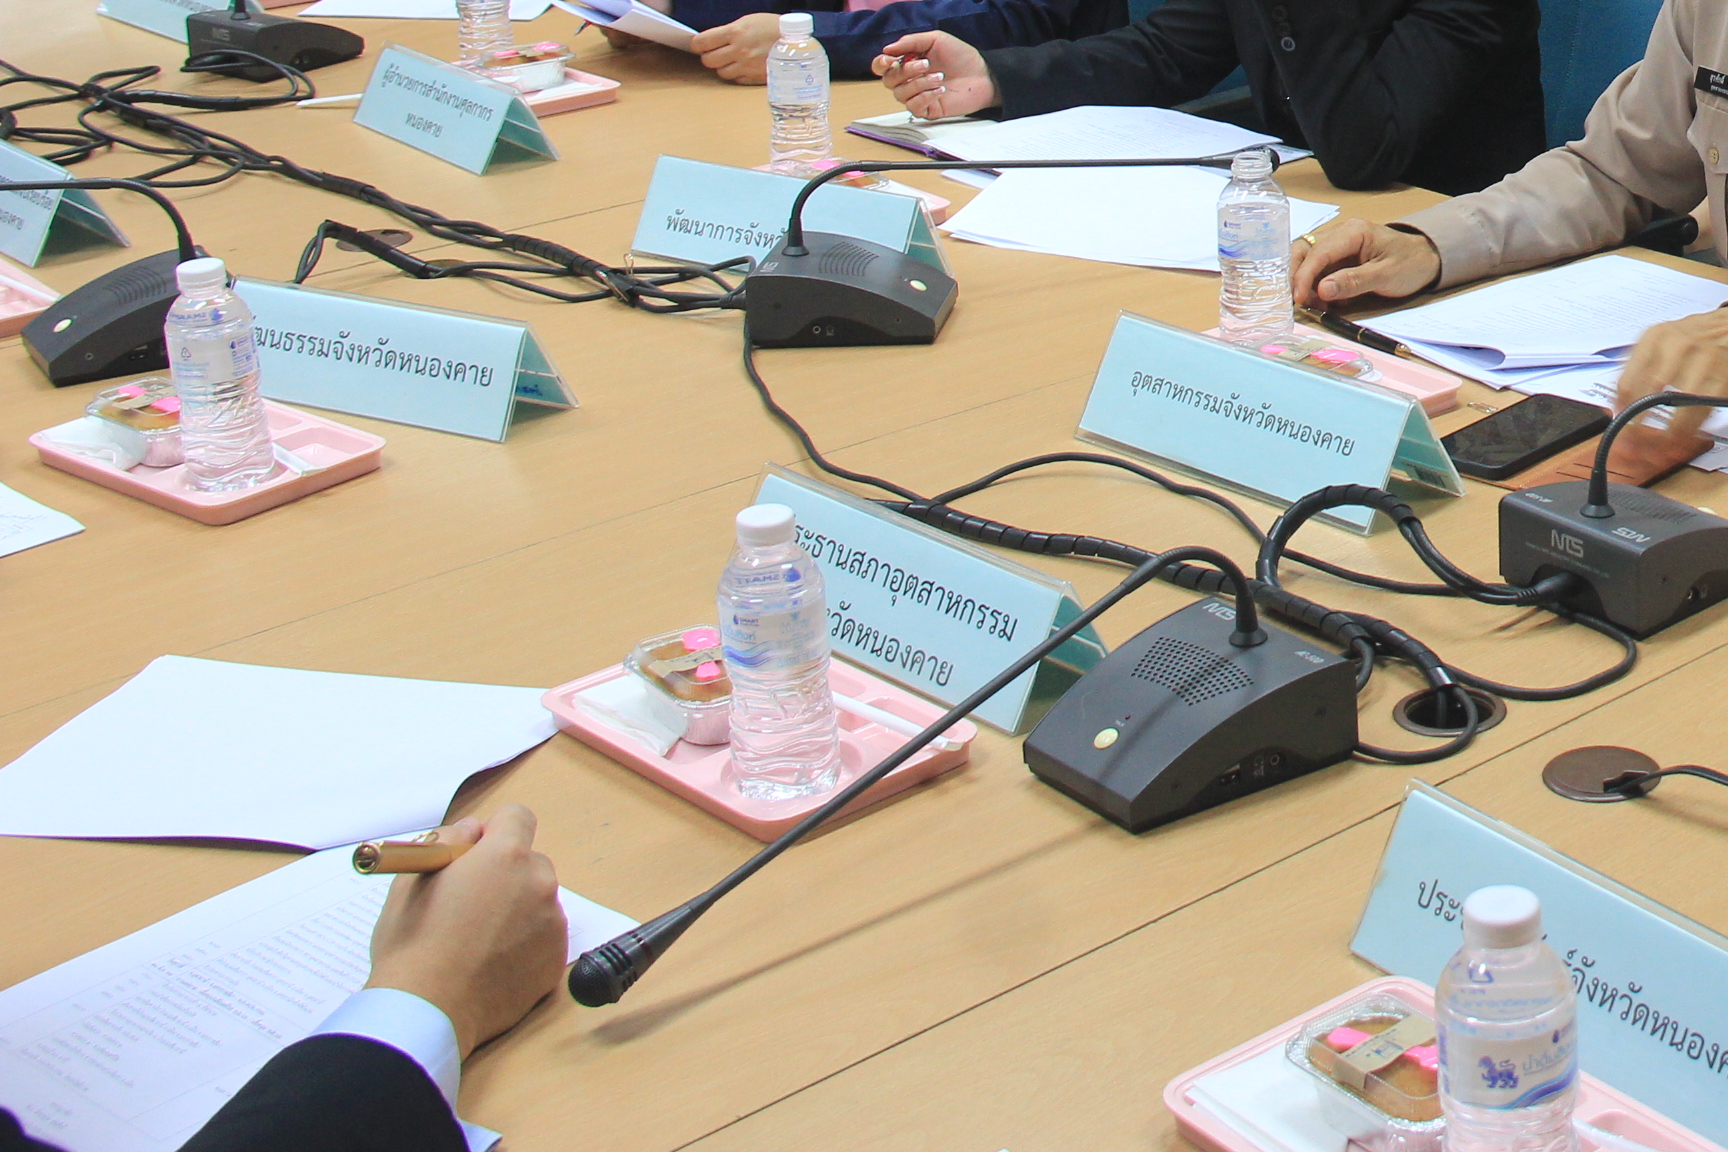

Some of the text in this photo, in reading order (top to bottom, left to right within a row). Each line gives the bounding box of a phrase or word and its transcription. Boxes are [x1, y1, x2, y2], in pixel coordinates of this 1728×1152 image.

[405, 113, 444, 138] หนองคาย
[254, 316, 494, 387] ฒนธรรมจังหวัดหนองคาย
[1131, 370, 1356, 457] อุตสาหกรรมจังหวัดหนองคาย
[794, 520, 1018, 642] ระธานสภาอุตสาหกรรม
[1551, 529, 1583, 558] NTS
[826, 600, 954, 687] วัดหนองคาย
